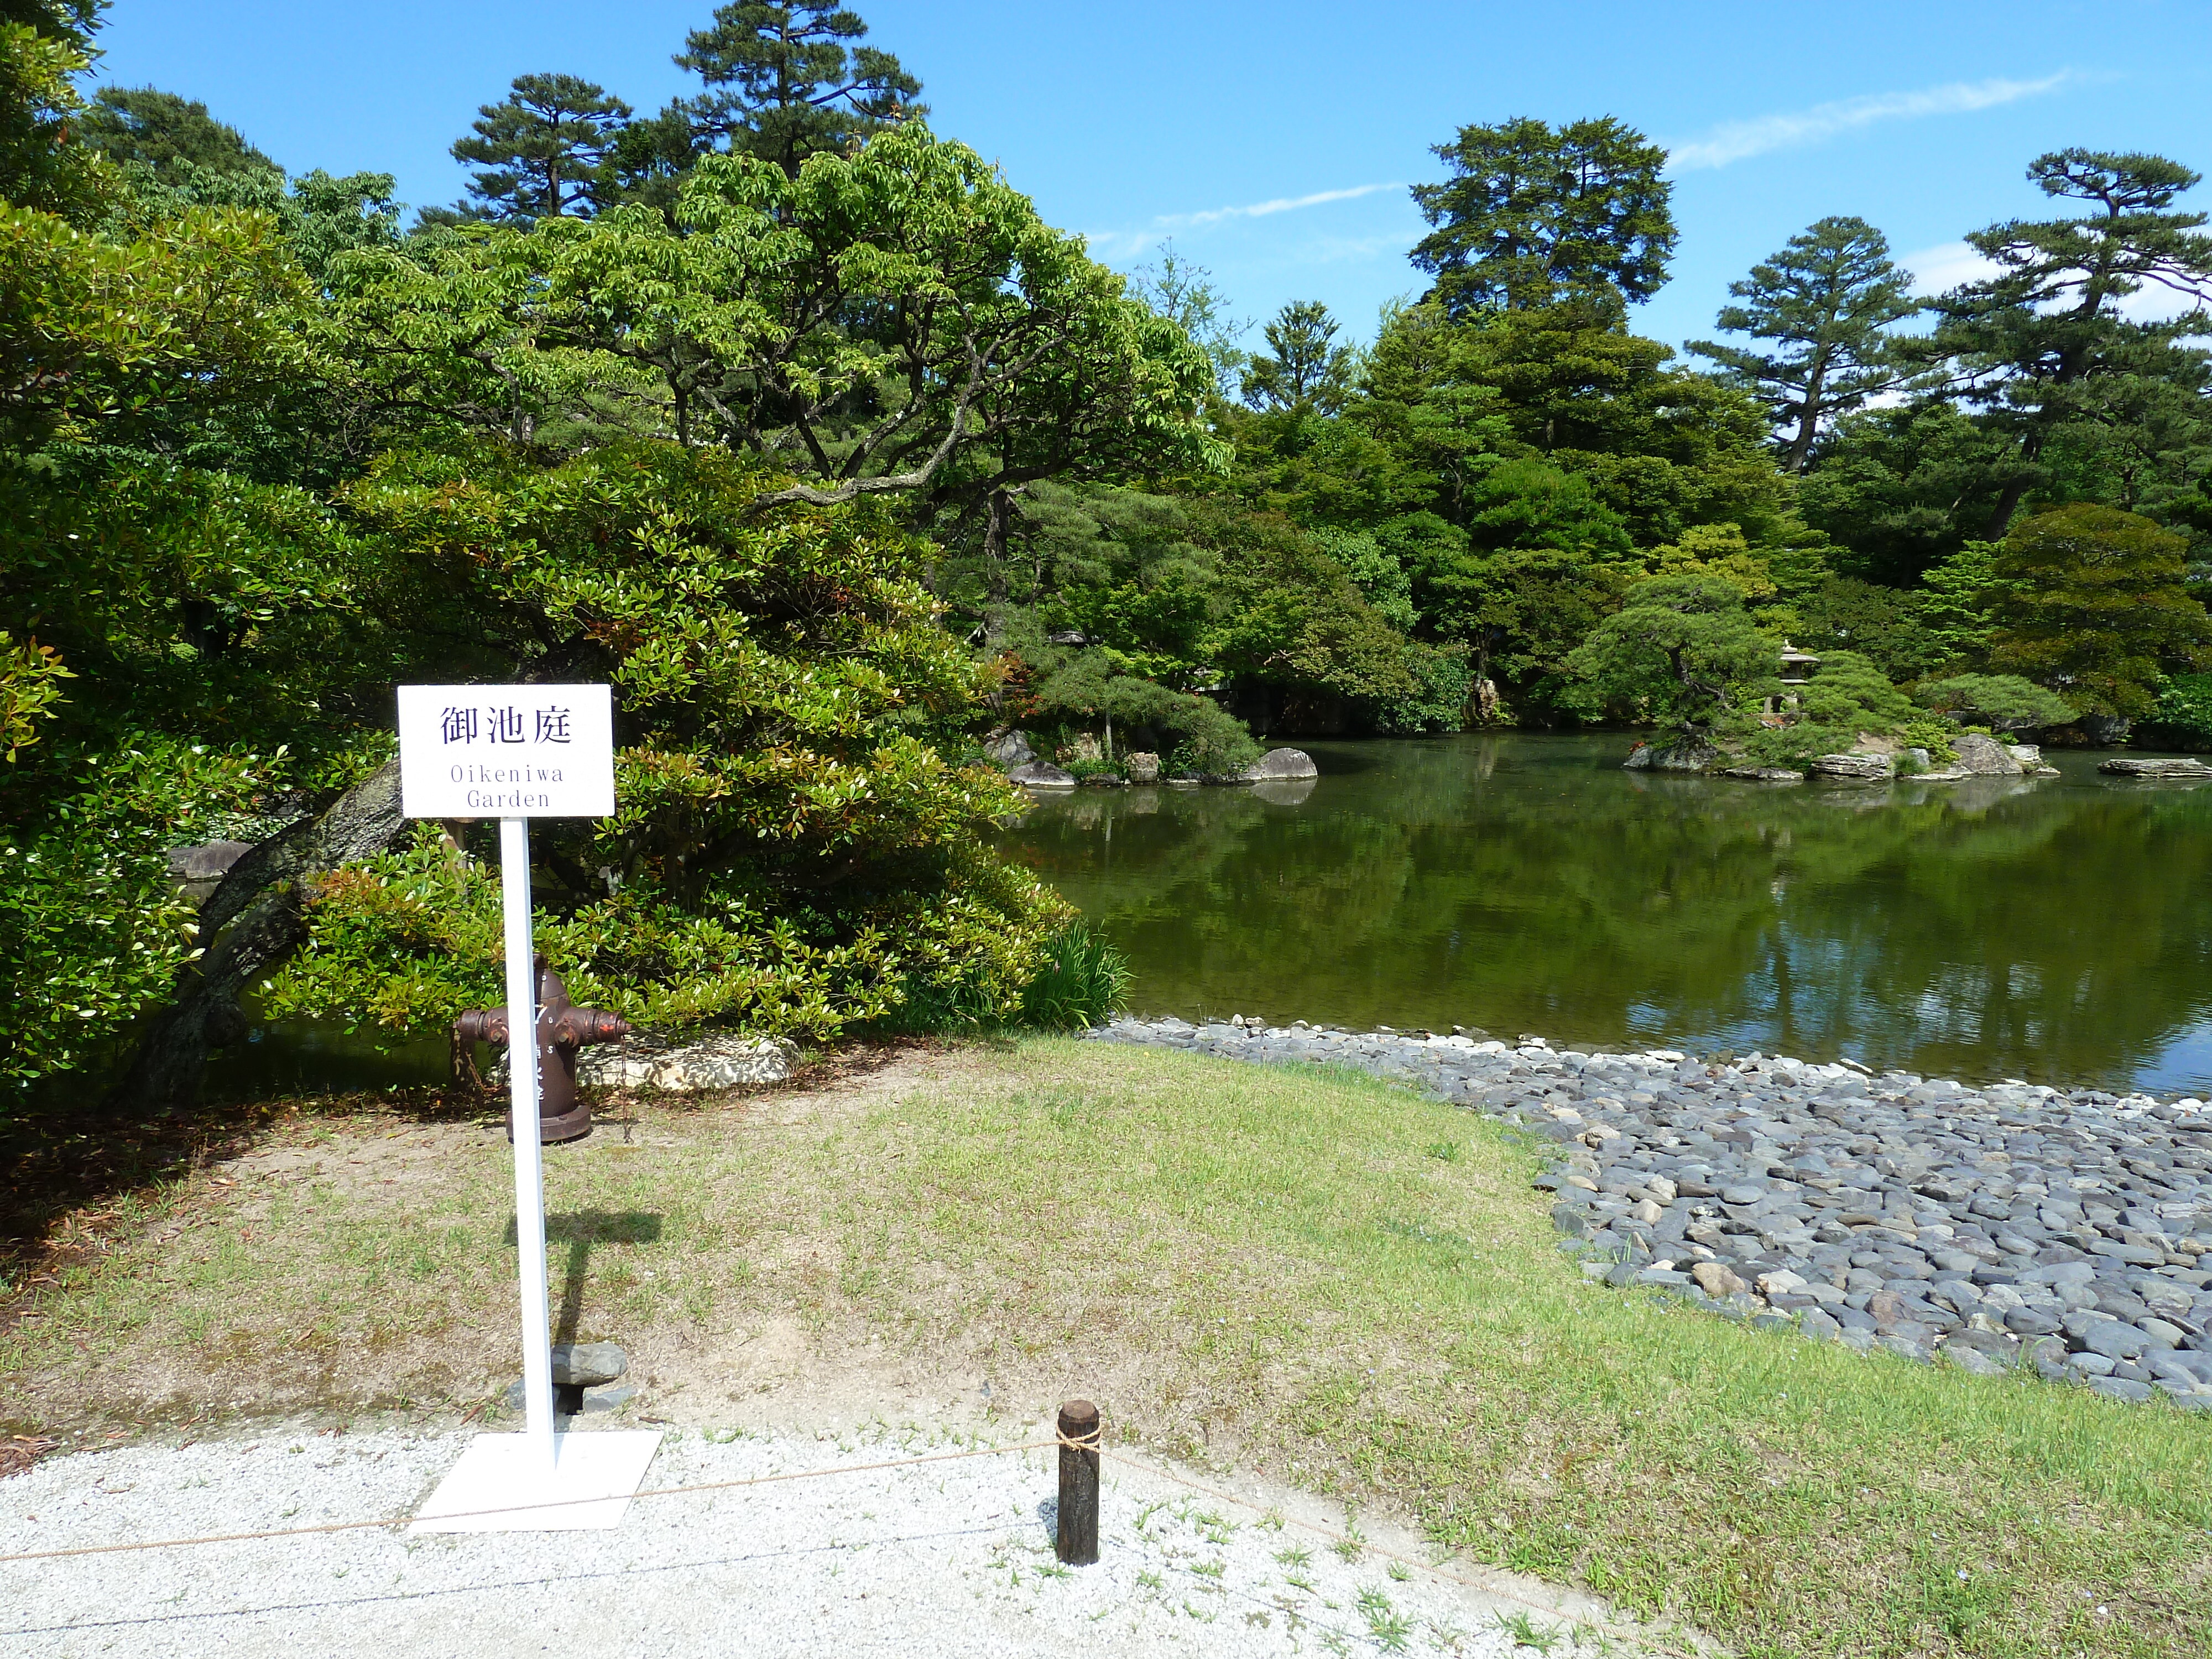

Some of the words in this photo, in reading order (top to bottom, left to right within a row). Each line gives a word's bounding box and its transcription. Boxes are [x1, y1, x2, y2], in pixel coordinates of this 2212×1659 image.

[441, 706, 571, 744] 御池庭
[451, 765, 562, 782] Oikeniwa
[468, 790, 548, 807] Garden
